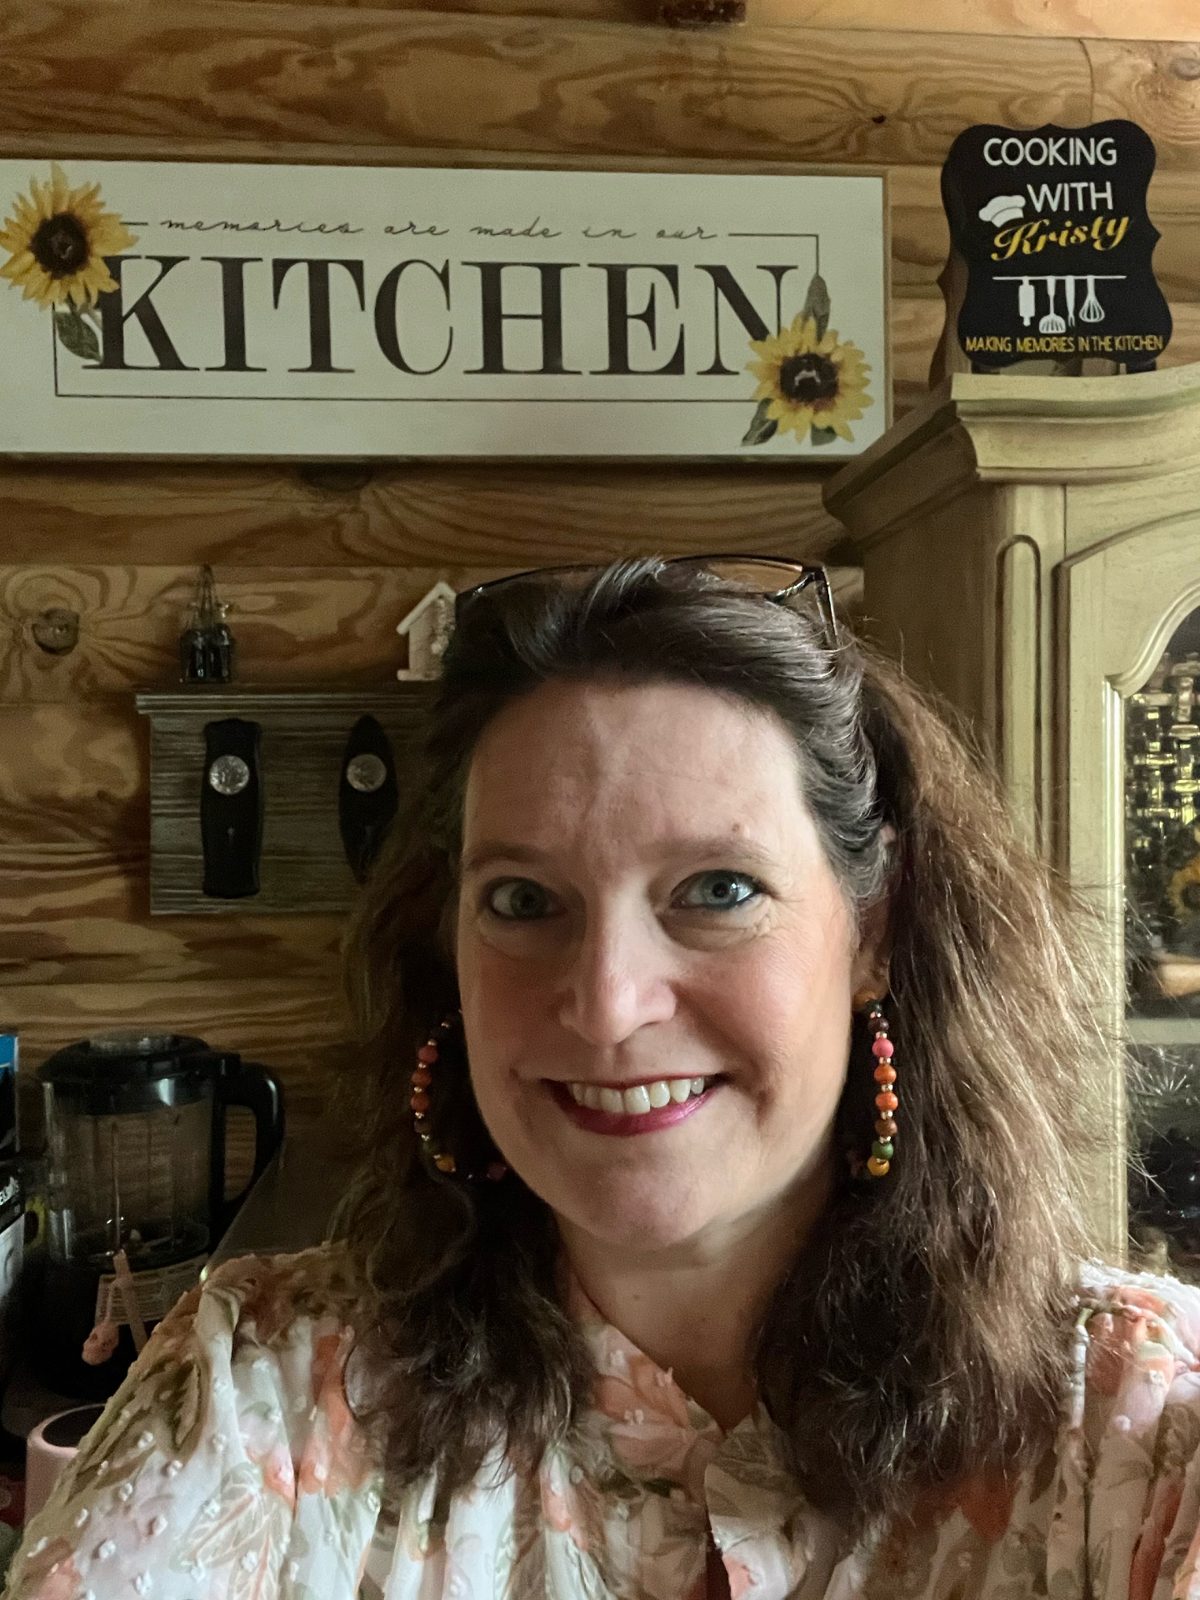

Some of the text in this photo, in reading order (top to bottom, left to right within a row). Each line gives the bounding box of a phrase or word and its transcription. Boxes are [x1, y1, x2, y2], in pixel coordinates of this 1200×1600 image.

[983, 137, 1117, 166] COOKING
[1027, 181, 1114, 213] WITH
[161, 216, 717, 240] memories are made in our
[991, 215, 1130, 262] Kristy
[82, 254, 798, 376] KITCHEN
[965, 335, 1163, 353] MAKING MEMORIES IN THE KITCHEN
